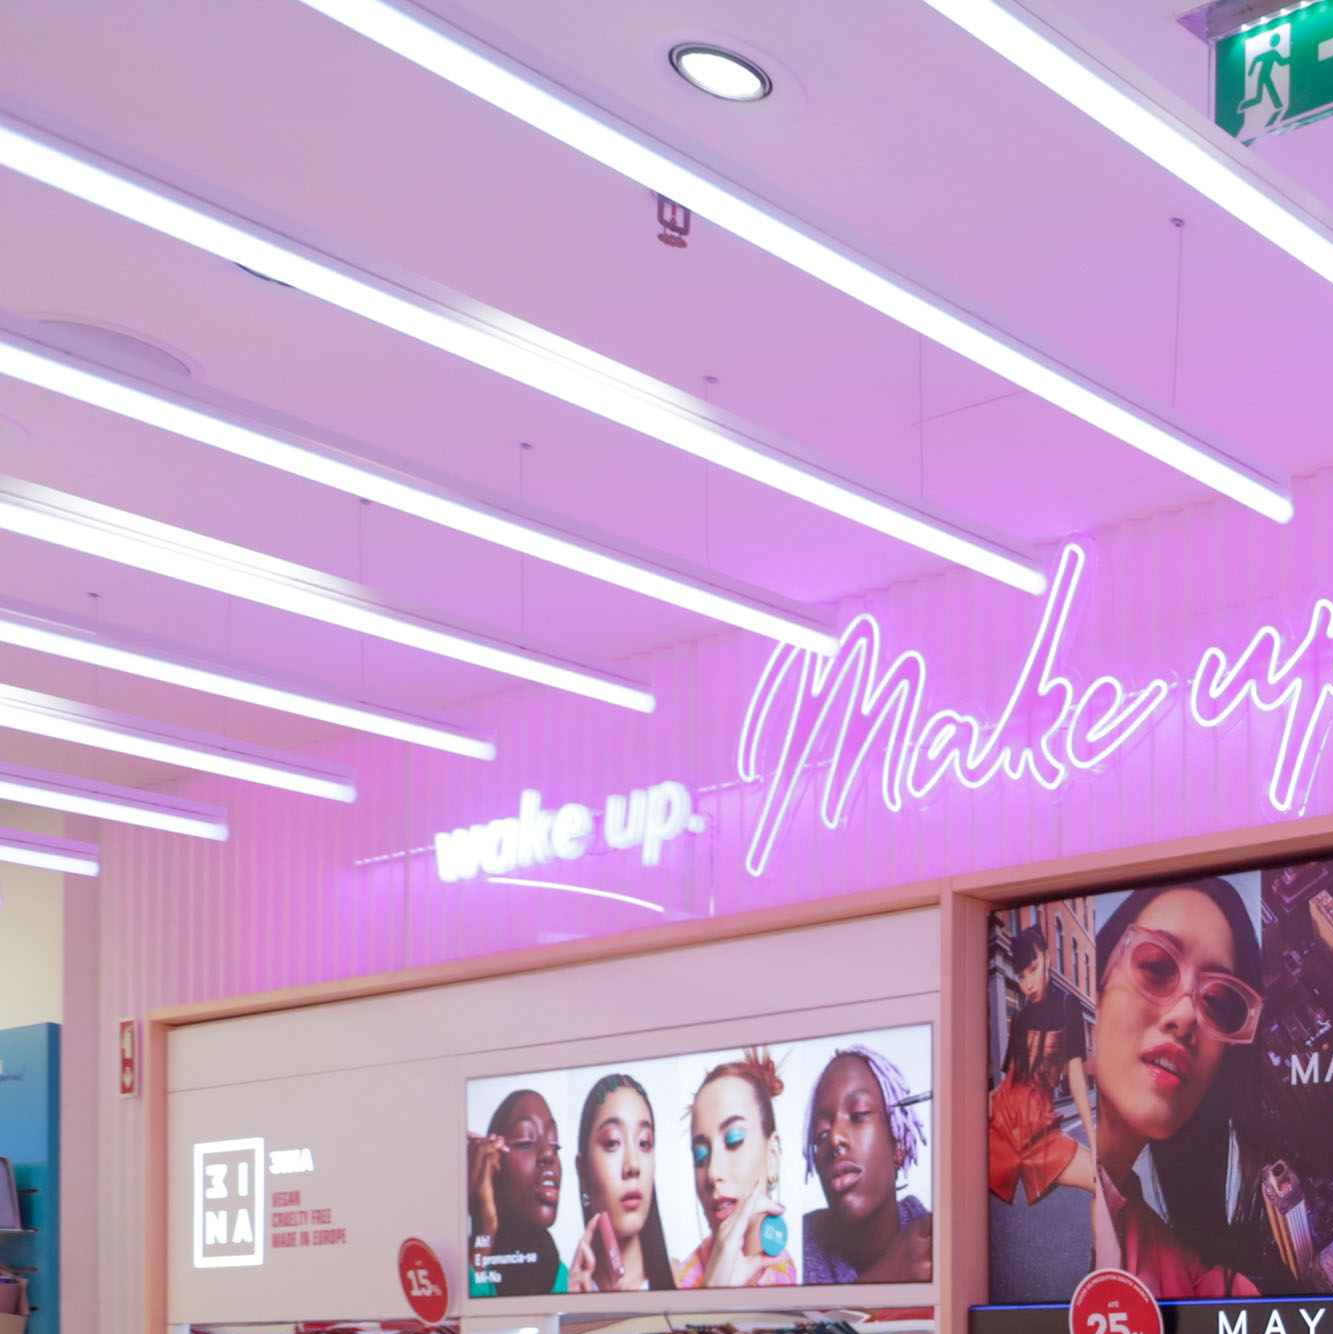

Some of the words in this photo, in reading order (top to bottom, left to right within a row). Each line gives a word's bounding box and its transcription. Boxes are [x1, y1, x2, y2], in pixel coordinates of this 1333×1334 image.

[738, 541, 1167, 876] Make
[435, 789, 593, 881] wake
[606, 781, 704, 866] up.
[271, 1211, 308, 1227] CRUELTY
[311, 1209, 332, 1224] FREE
[272, 1231, 297, 1248] MADE
[300, 1230, 310, 1246] IN
[313, 1228, 347, 1245] EUROPE
[482, 1250, 538, 1266] pronuncia-se
